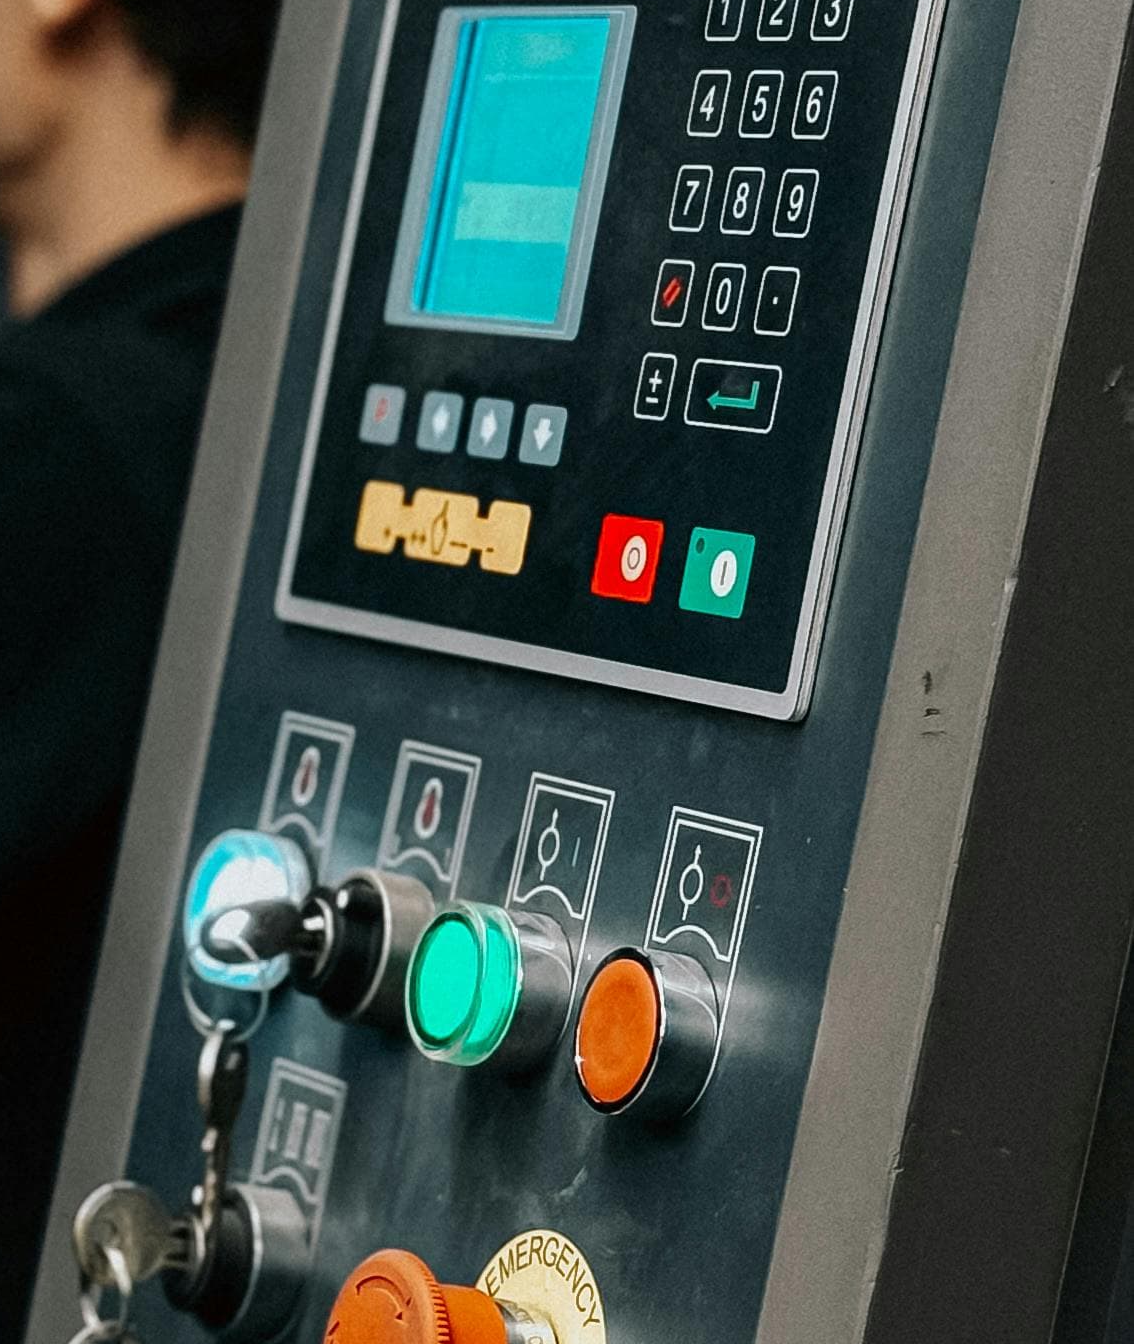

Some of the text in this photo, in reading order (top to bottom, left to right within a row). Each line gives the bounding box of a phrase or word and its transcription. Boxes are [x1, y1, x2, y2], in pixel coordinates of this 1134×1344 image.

[699, 84, 824, 124] 4 5 6
[682, 180, 805, 222] 7 8 9
[484, 1234, 602, 1328] EMERGENCY
